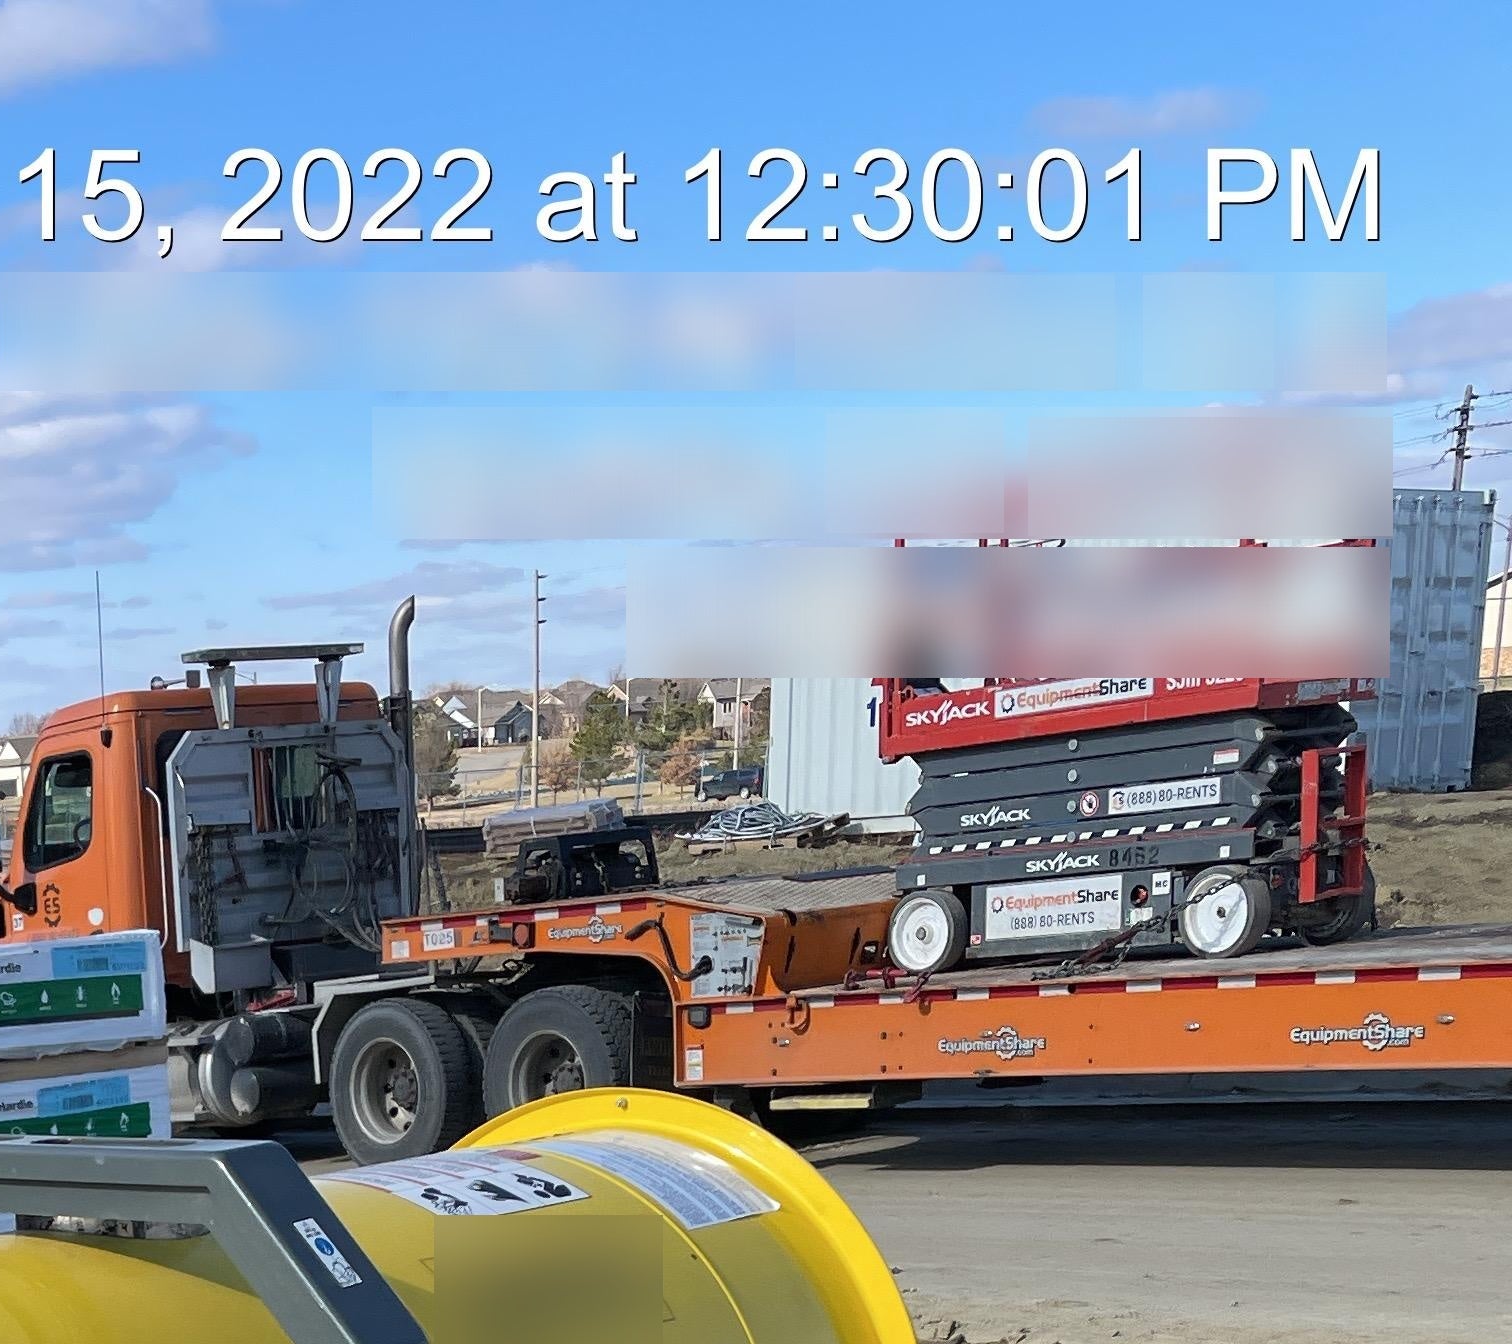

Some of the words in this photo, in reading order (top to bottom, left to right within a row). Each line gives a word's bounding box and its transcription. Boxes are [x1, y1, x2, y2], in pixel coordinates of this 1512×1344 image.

[1017, 678, 1148, 710] EquipmentShare
[905, 699, 991, 727] SKYJACK
[1126, 791, 1157, 808] (888)
[1157, 783, 1218, 803] 80-RENTS
[960, 805, 1031, 828] SKYJACK
[1025, 851, 1100, 873] SKYJACK
[1006, 888, 1119, 911] EquipmentShare
[1010, 914, 1037, 931] (888)
[1038, 910, 1095, 929] 80-RENTS
[938, 1036, 1046, 1055] EquipmentShare
[1290, 1025, 1425, 1046] EquipmentShare
